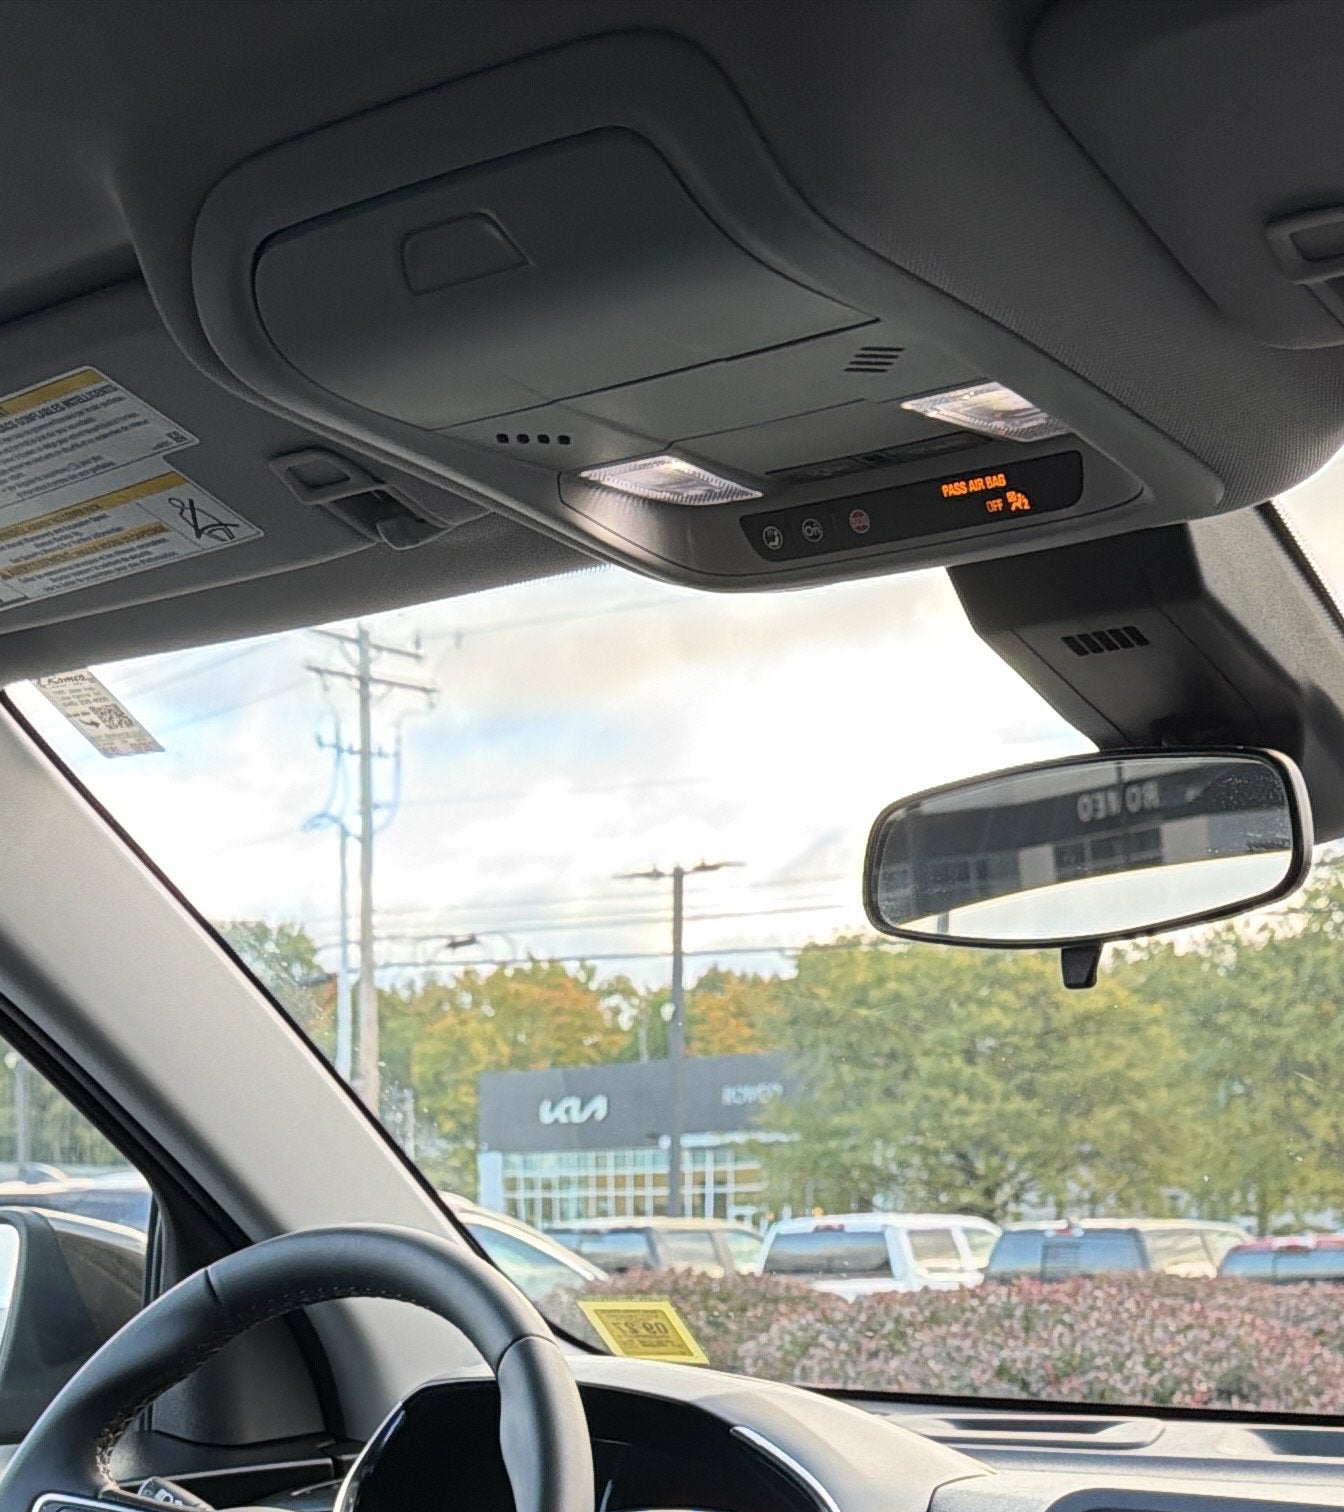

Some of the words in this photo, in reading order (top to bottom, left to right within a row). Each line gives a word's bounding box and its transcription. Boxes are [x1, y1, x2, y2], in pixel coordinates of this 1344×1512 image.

[942, 482, 968, 497] PASS
[968, 478, 986, 493] AIR
[986, 473, 1006, 488] BAG
[986, 499, 1003, 513] OFF
